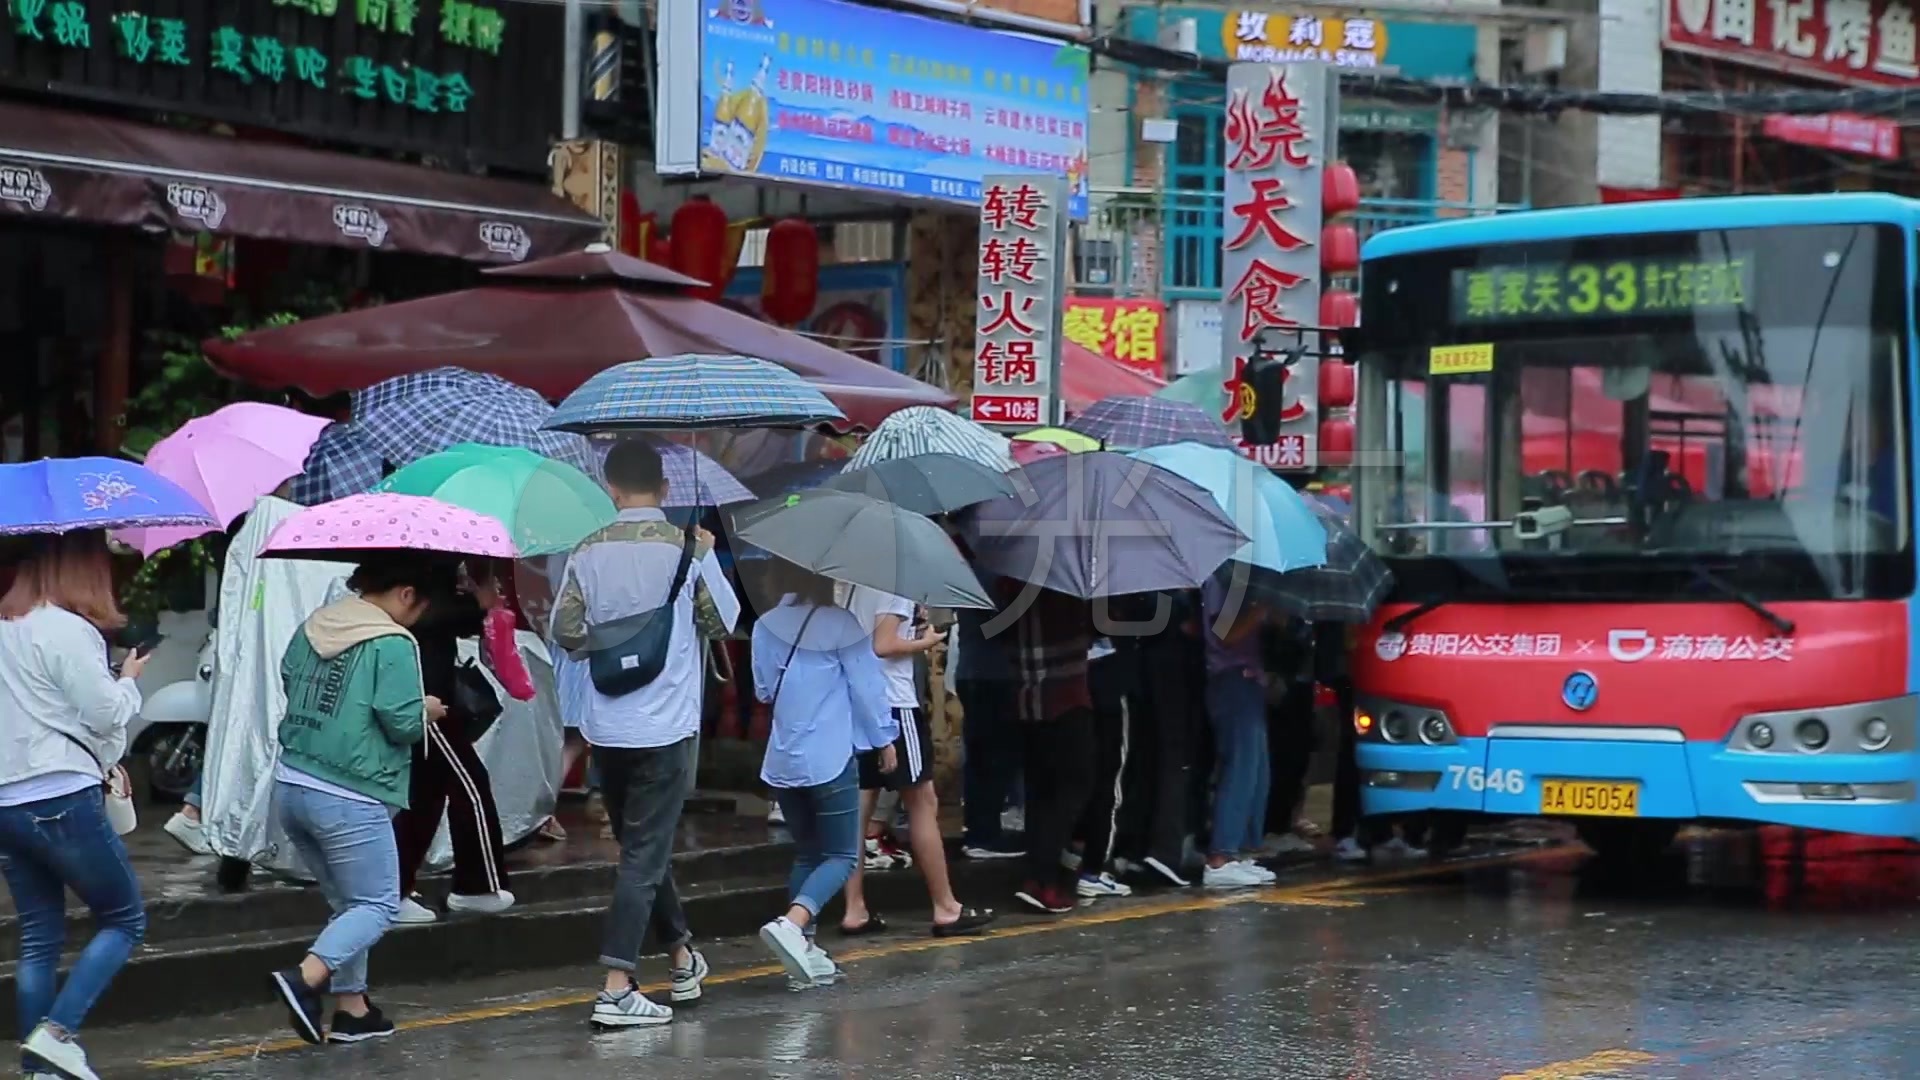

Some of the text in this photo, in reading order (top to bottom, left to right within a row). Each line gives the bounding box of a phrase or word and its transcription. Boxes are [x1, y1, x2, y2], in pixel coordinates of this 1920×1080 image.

[978, 183, 1041, 387] 转转火锅
[1567, 261, 1638, 314] 33
[1004, 401, 1037, 421] 10米
[1407, 633, 1562, 658] 贵阳公交集团
[1661, 635, 1795, 662] 滴滴公交
[1448, 765, 1525, 794] 7646
[1571, 786, 1635, 811] U5054
